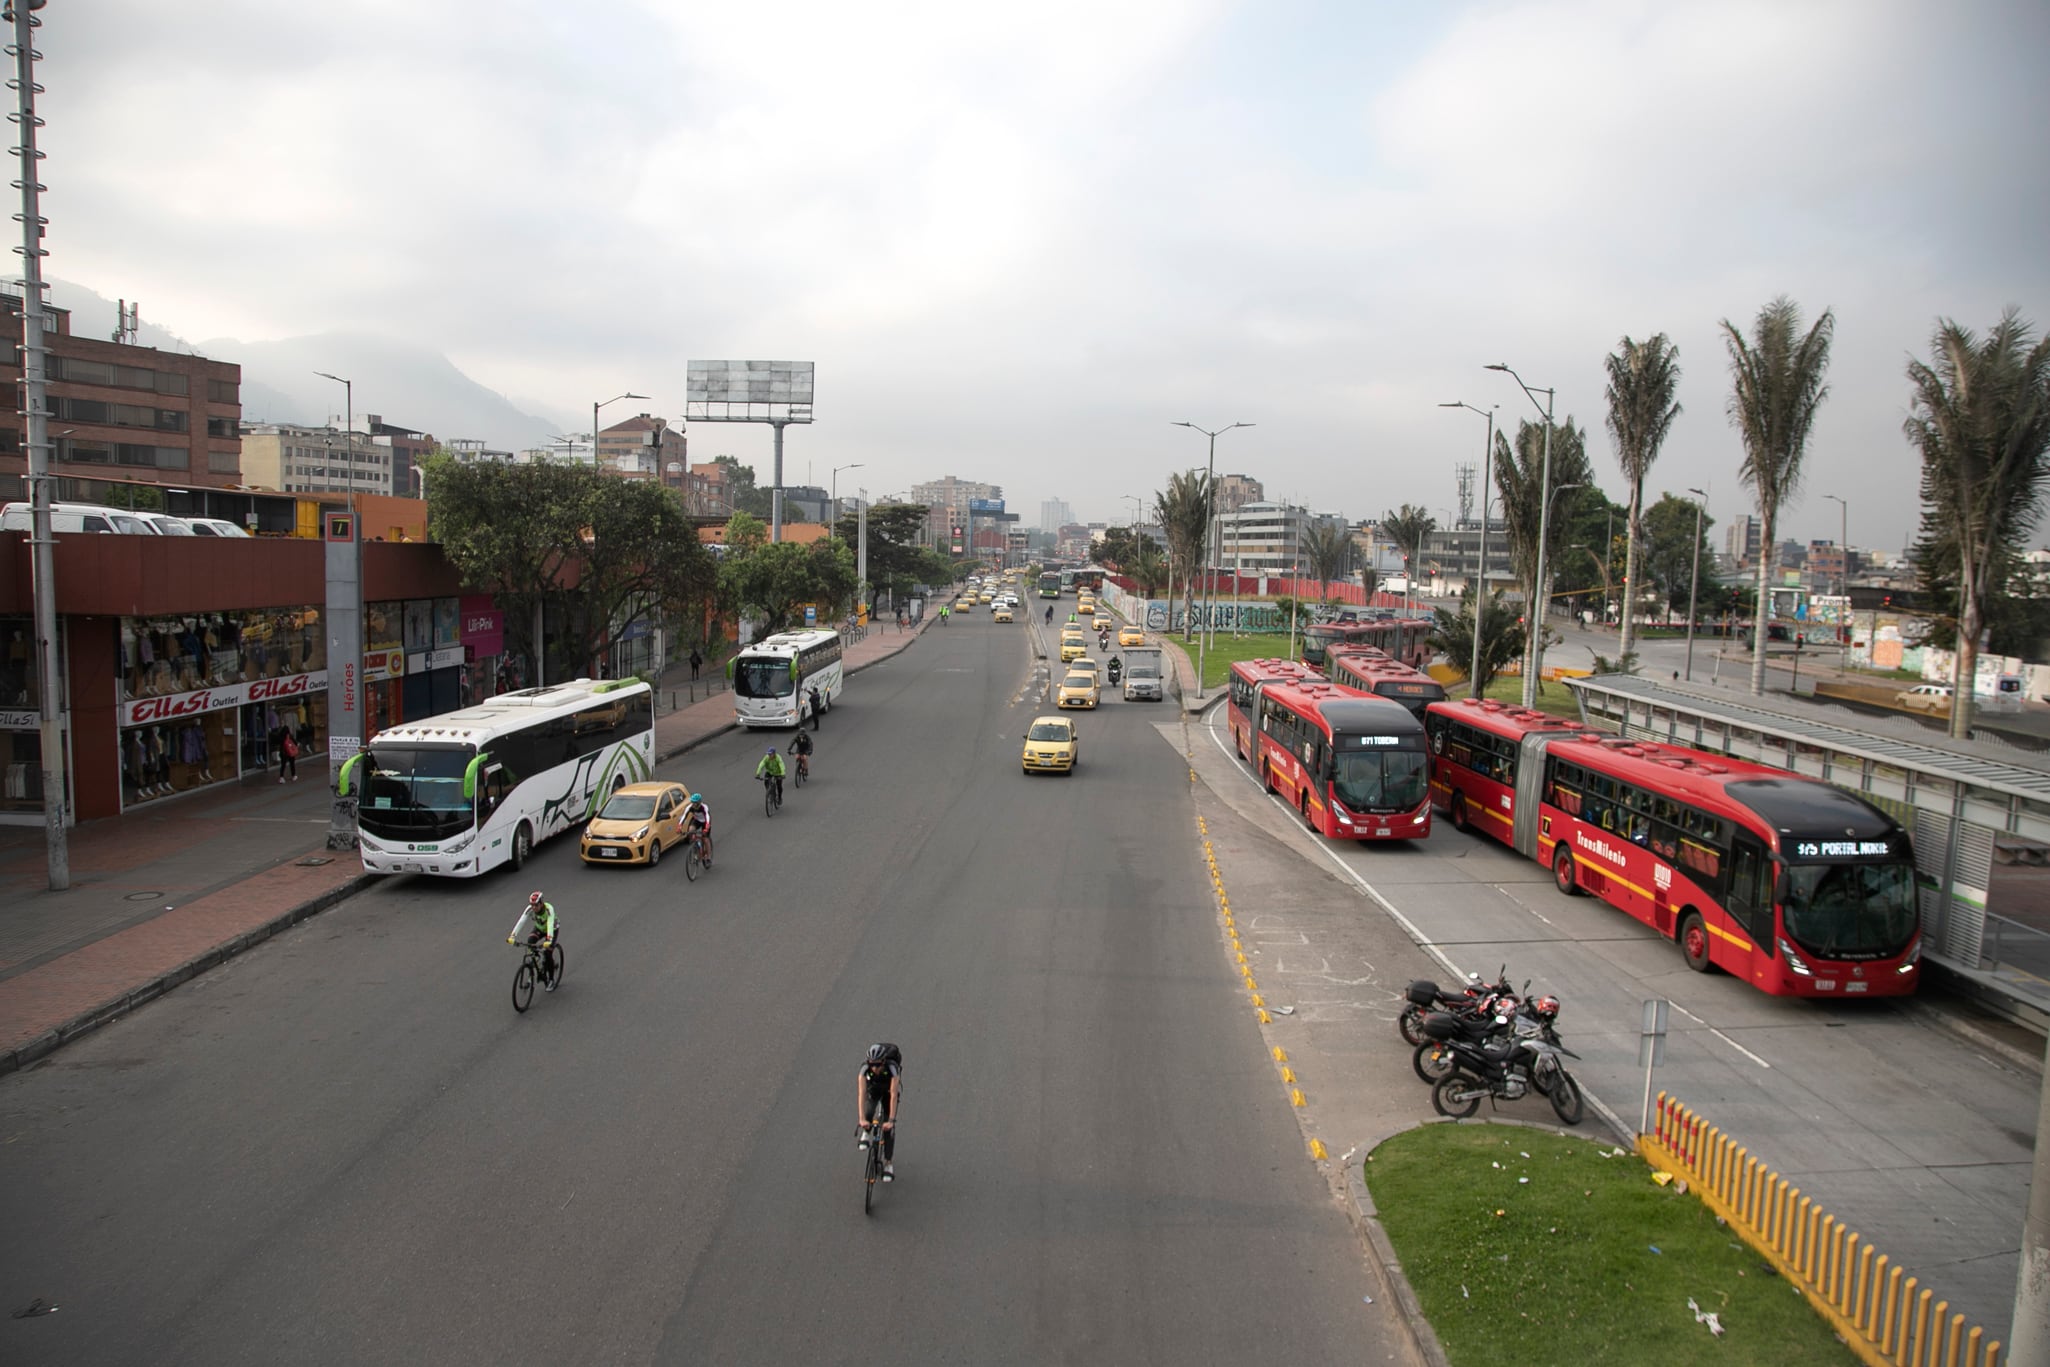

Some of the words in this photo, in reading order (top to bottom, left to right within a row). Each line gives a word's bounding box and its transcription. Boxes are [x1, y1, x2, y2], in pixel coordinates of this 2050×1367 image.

[344, 663, 354, 711] Héroes
[212, 695, 239, 708] Outlet
[1577, 830, 1626, 867] TransMilenio
[1821, 842, 1859, 856] PORTAL
